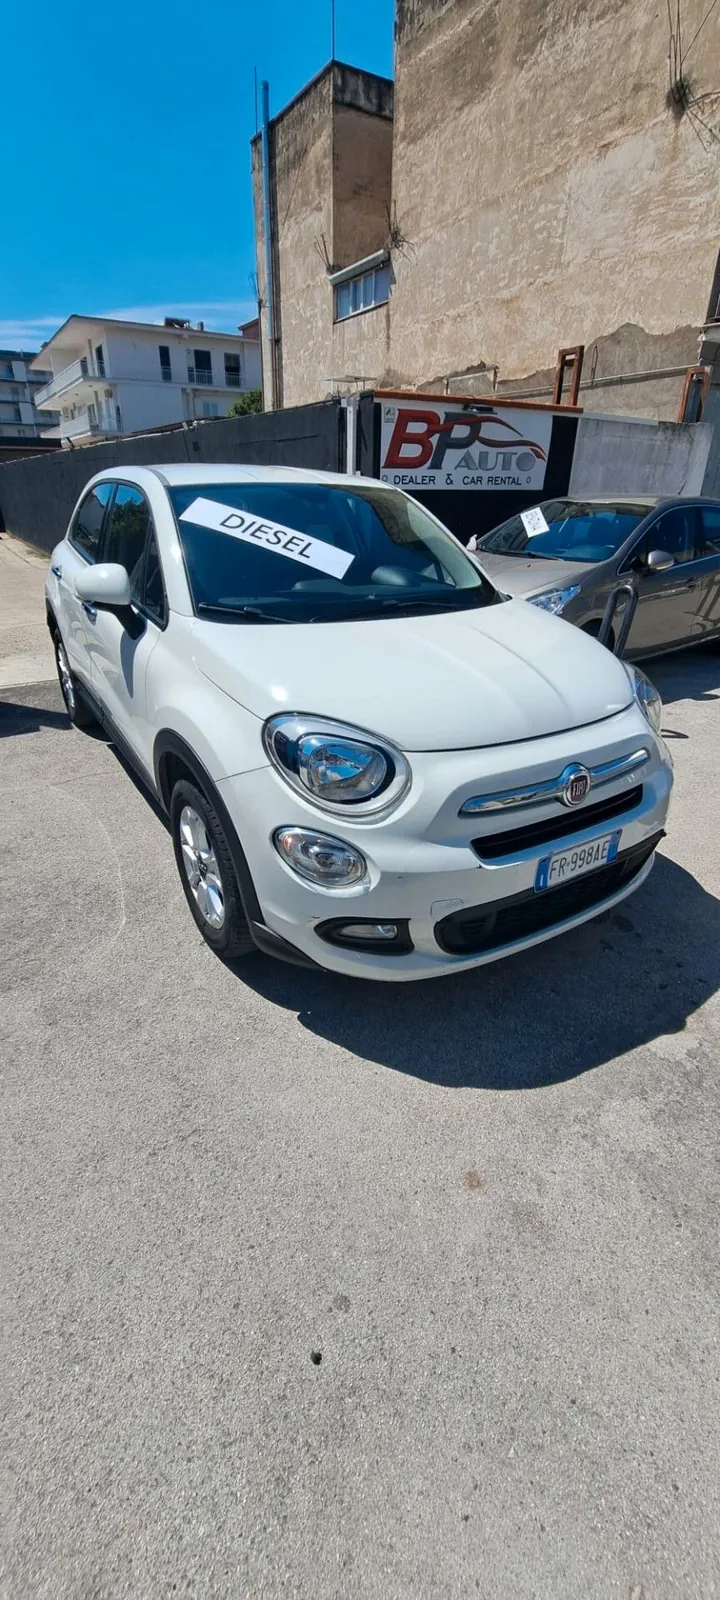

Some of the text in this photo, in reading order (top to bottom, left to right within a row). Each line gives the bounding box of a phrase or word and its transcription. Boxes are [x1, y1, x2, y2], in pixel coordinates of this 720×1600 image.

[382, 408, 481, 470] BP
[454, 450, 536, 472] AUTO
[393, 473, 522, 486] DEALER & CAR RENTAL
[219, 513, 312, 558] DIESEL
